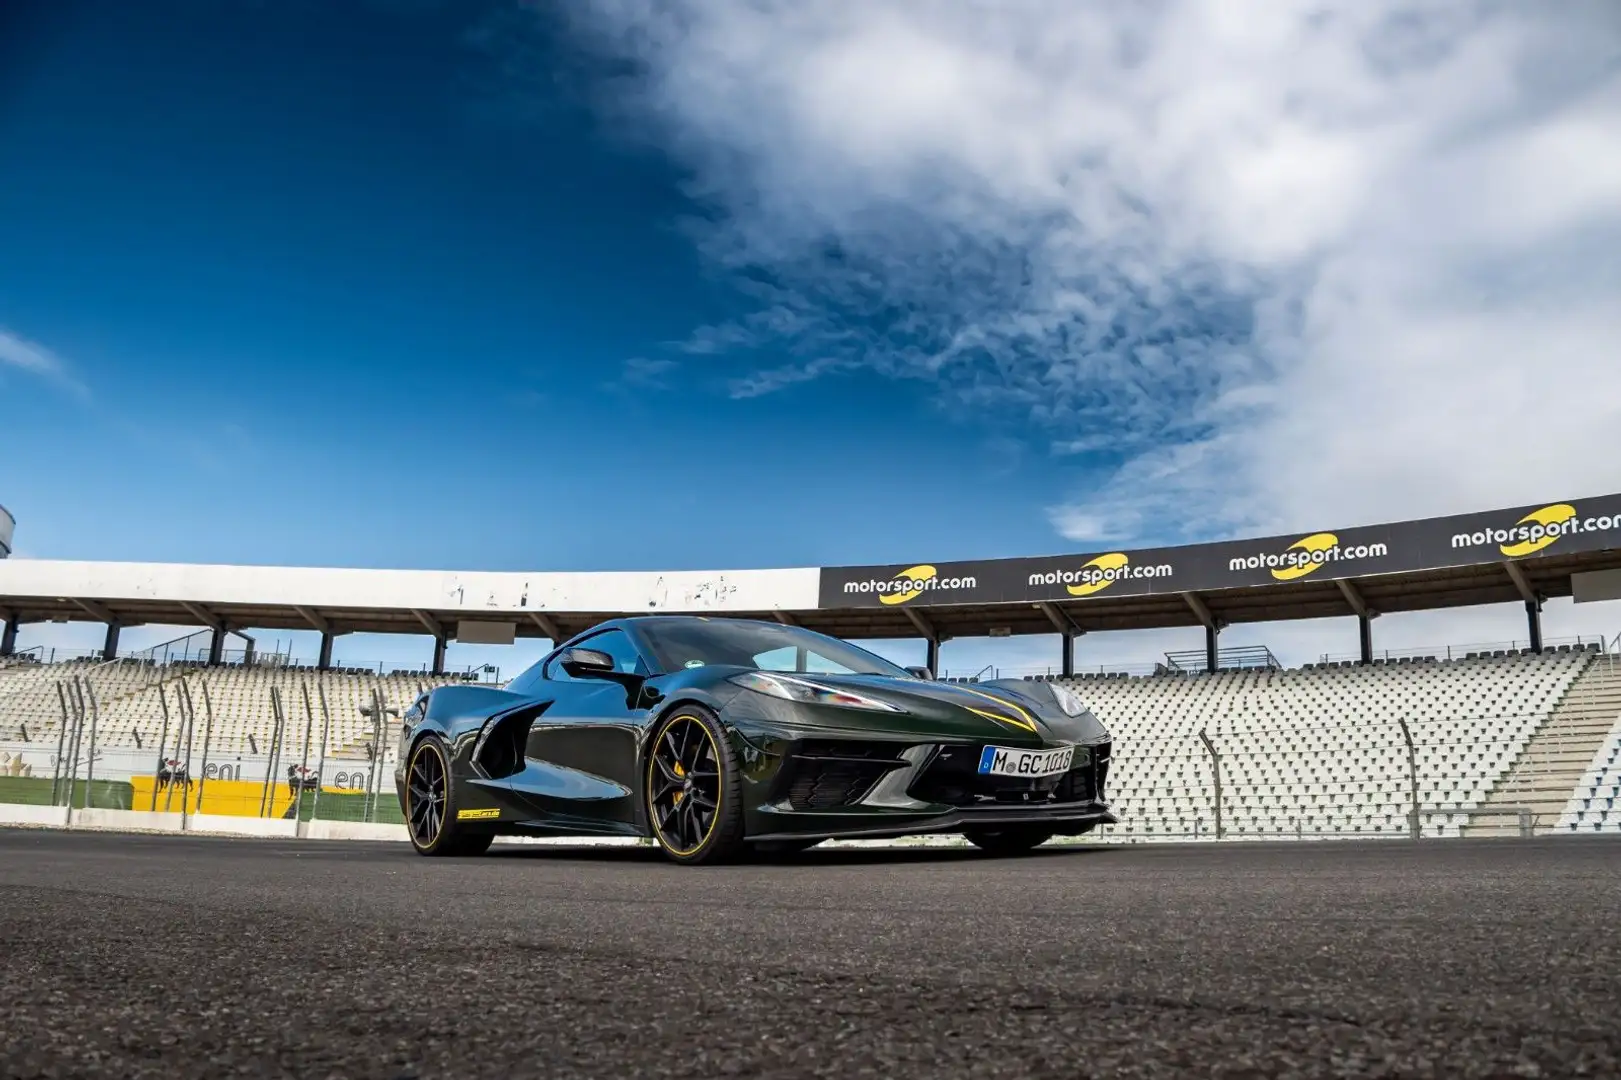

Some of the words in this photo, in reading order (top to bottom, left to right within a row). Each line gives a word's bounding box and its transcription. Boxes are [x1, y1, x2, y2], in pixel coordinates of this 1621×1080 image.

[1229, 544, 1388, 572] motorsport.com
[843, 575, 977, 595] motorsport.com
[1028, 564, 1173, 587] motorsport.com
[203, 756, 241, 781] eni
[992, 751, 1008, 772] M
